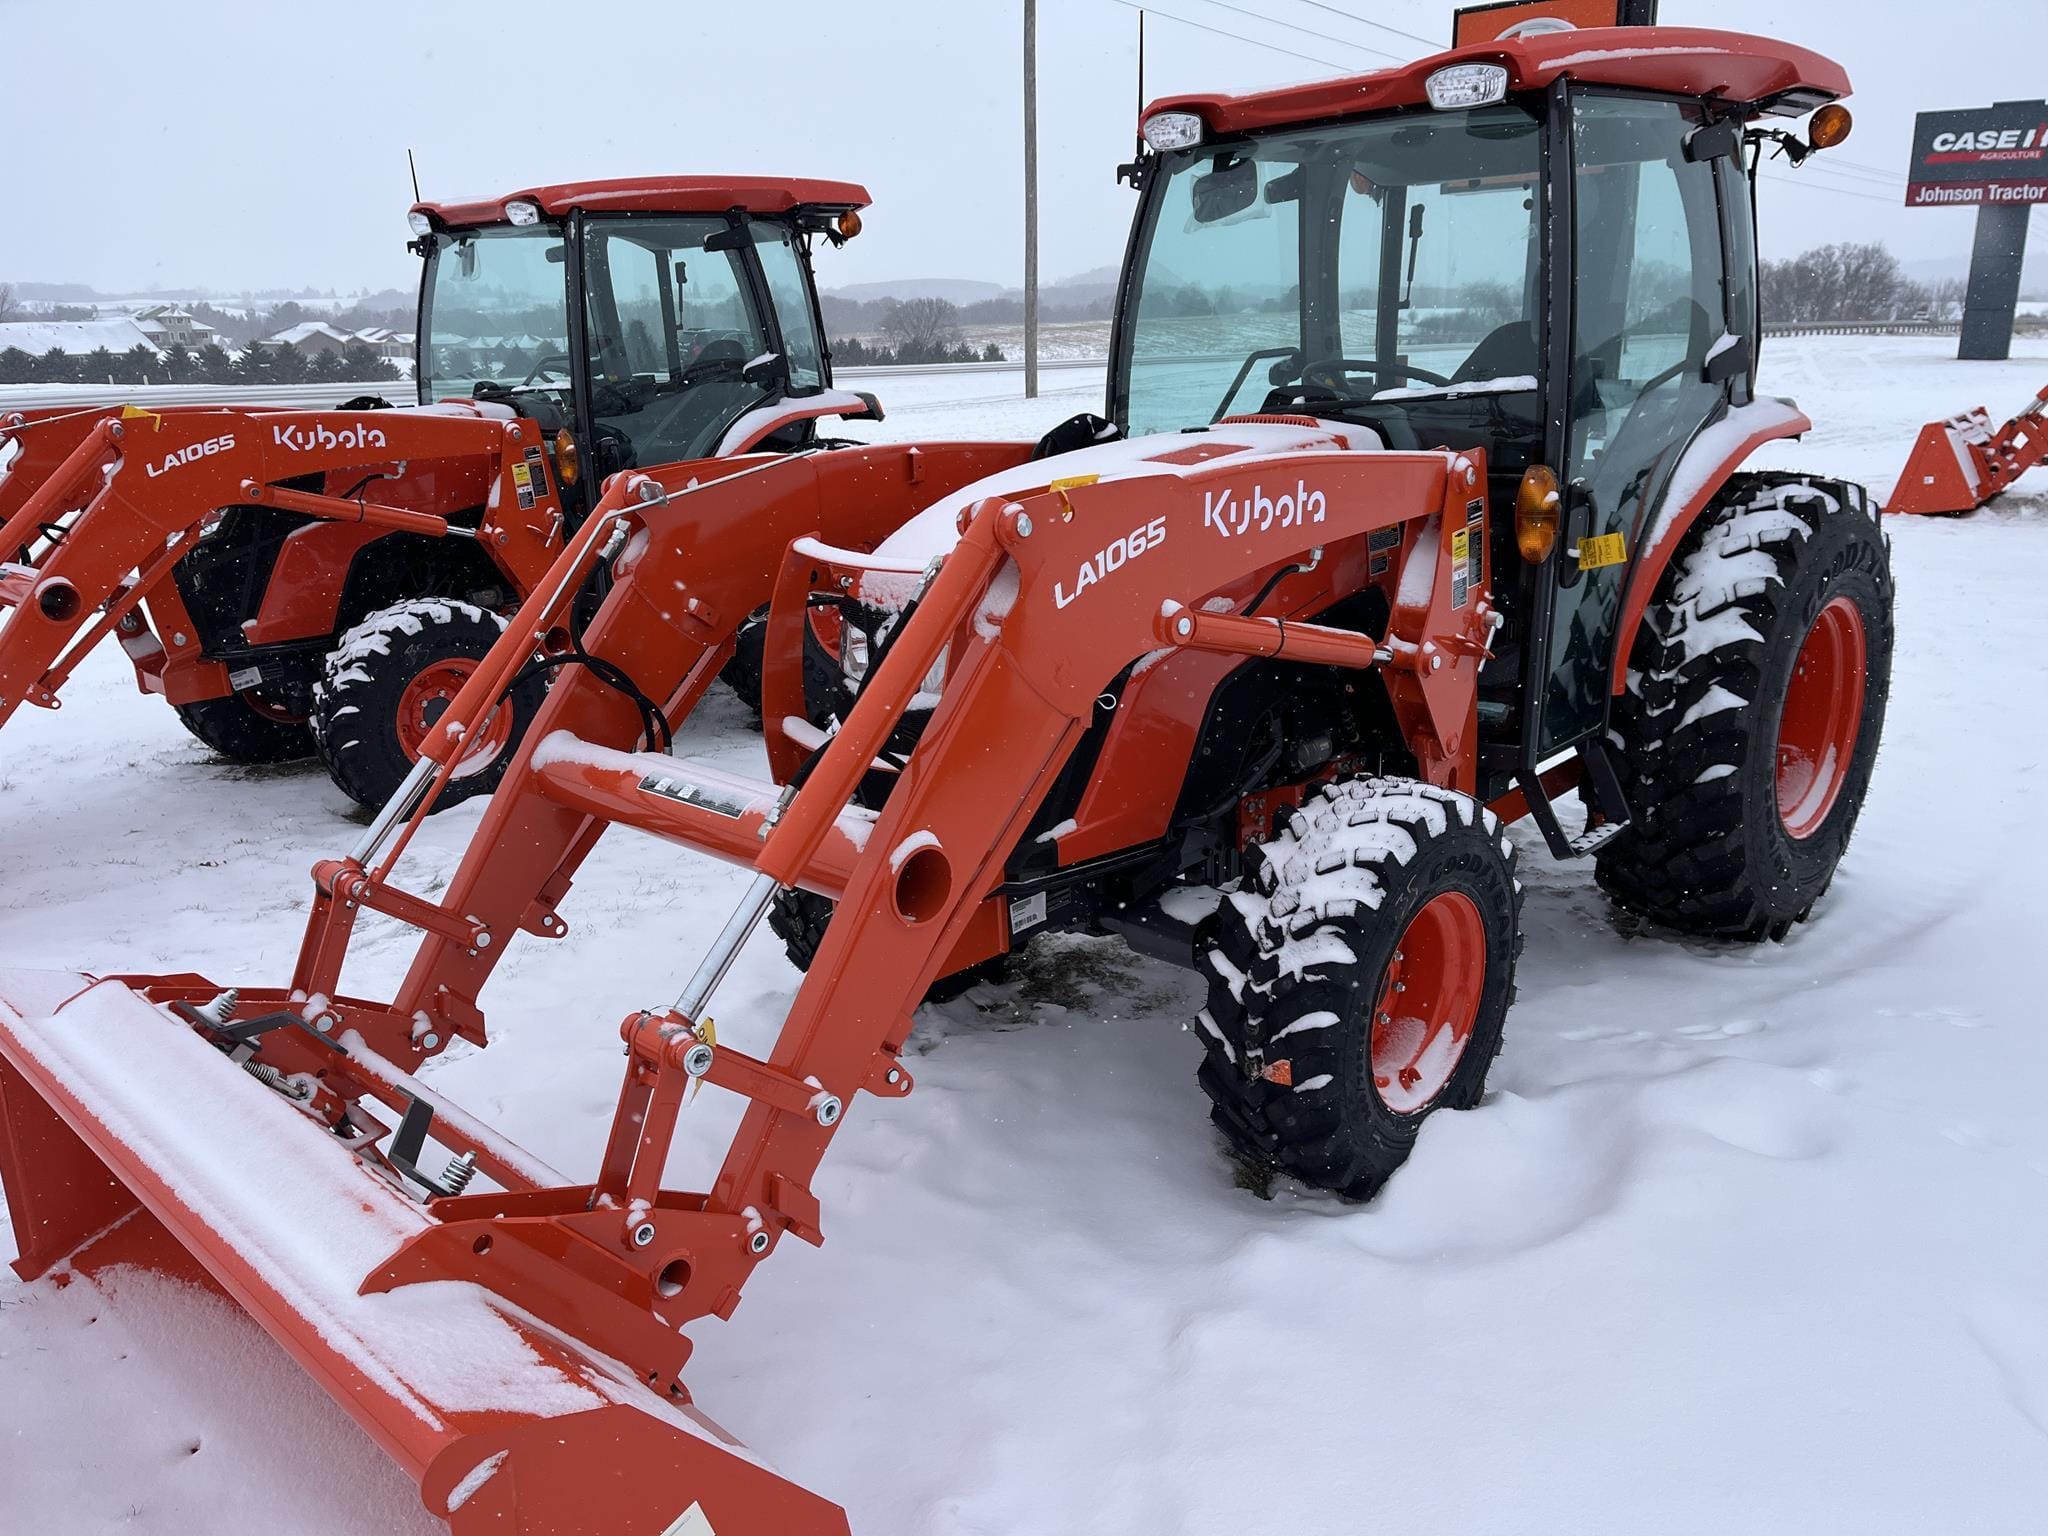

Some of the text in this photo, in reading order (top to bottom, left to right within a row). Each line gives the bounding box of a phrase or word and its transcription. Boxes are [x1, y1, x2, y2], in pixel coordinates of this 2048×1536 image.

[1932, 129, 2021, 152] CASE
[1980, 150, 2042, 160] AGRICULTURE
[1915, 184, 2047, 203] Johnson Tractor
[273, 423, 386, 451] Kubota
[145, 434, 236, 478] LA1065
[1204, 480, 1326, 537] Kubota
[1054, 516, 1166, 609] LA1065
